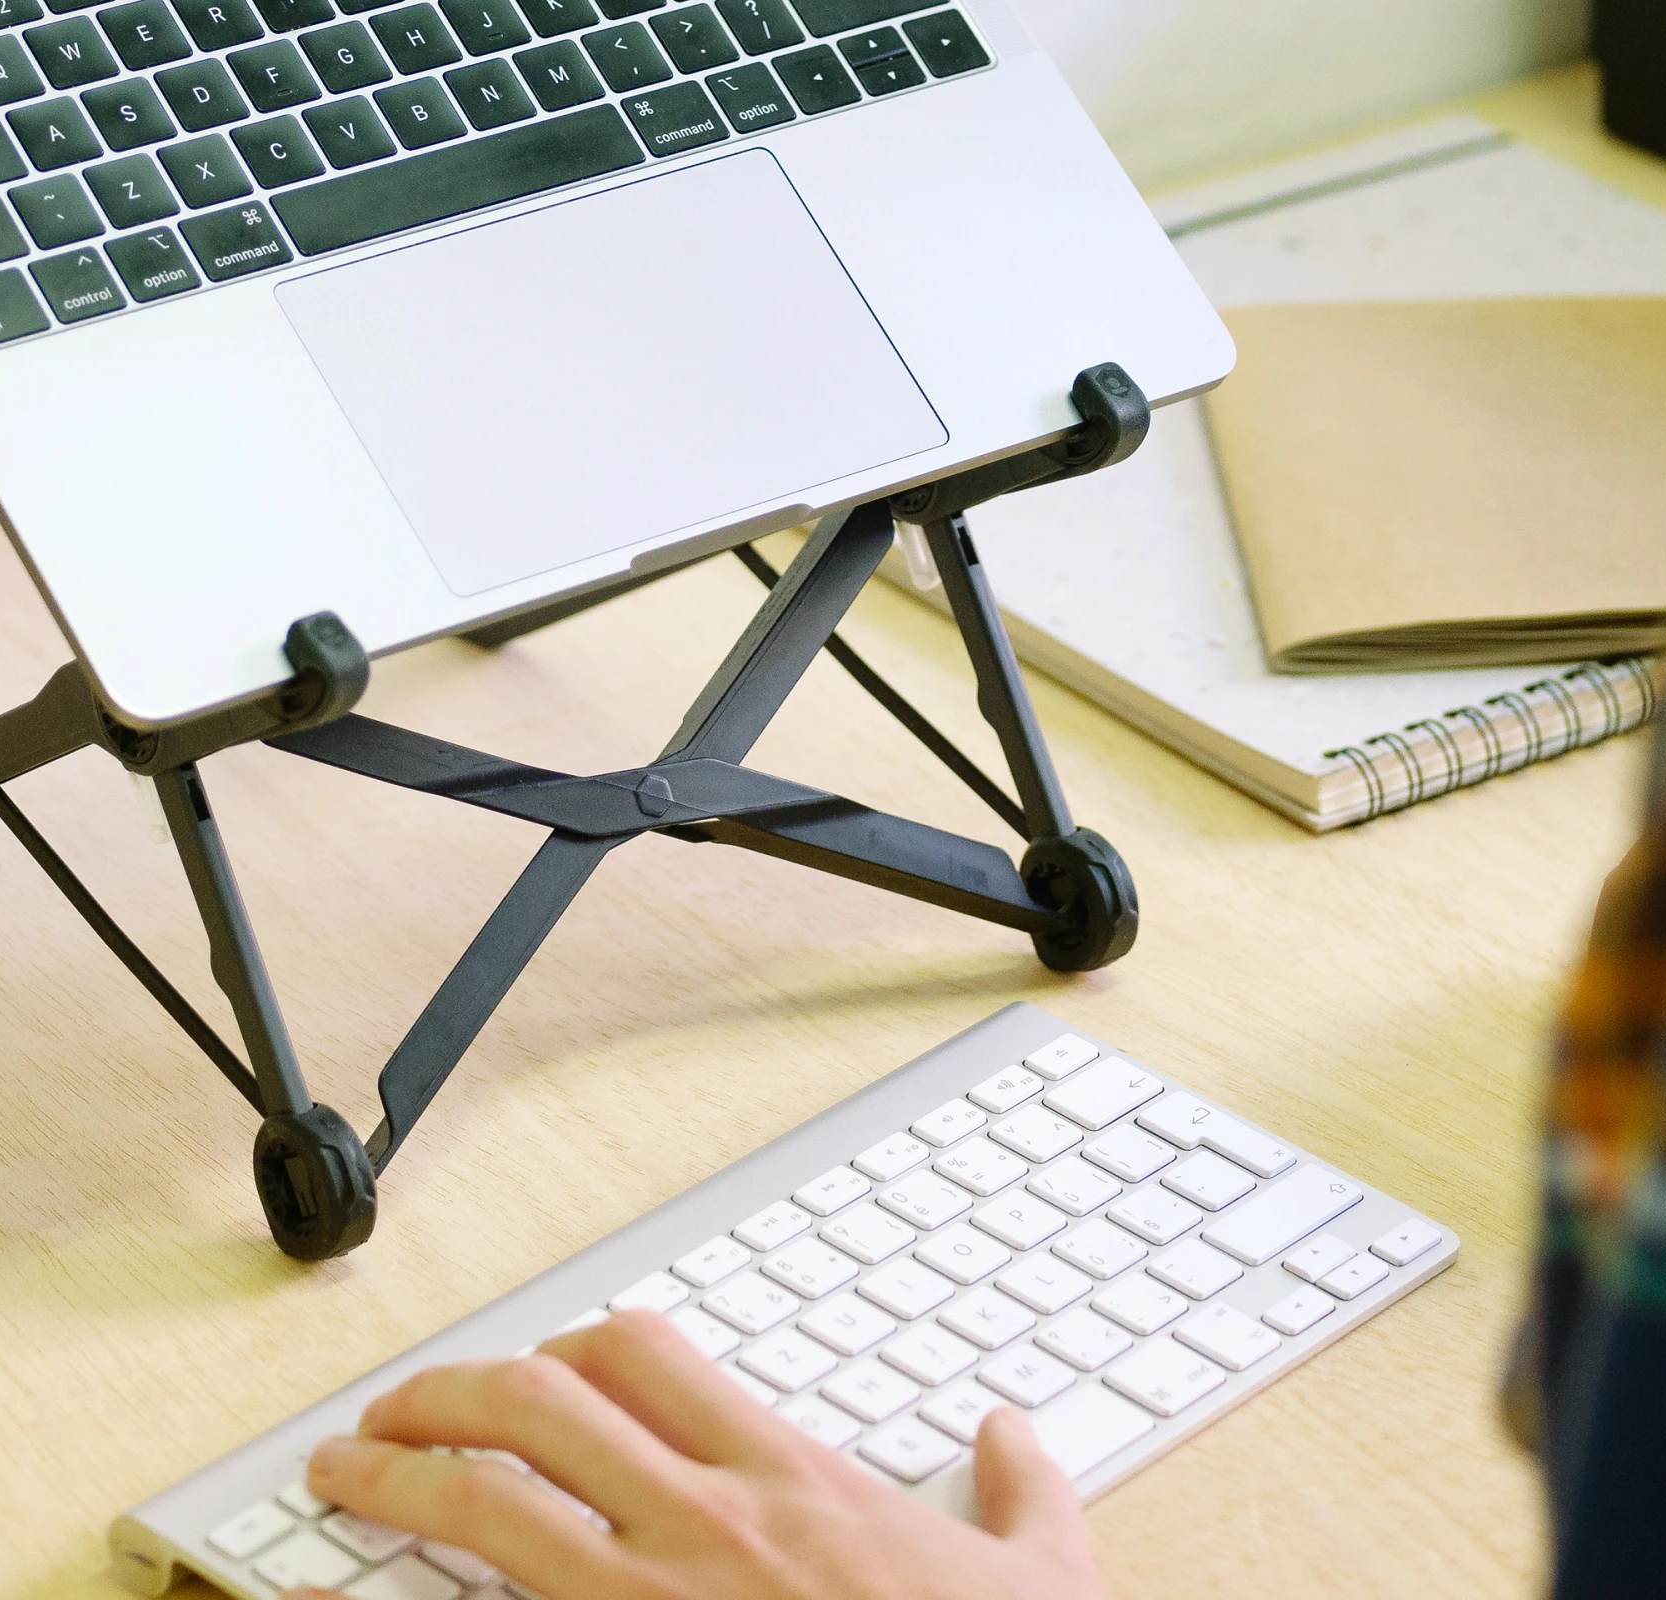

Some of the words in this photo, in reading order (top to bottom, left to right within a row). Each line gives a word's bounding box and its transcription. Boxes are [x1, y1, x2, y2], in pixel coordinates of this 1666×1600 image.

[207, 6, 227, 23] R
[482, 11, 493, 28] J
[136, 24, 154, 42] E
[405, 29, 426, 47] H
[58, 42, 81, 61] W
[337, 48, 354, 65] G
[265, 66, 279, 84] F
[548, 65, 570, 84] M
[192, 86, 210, 104] D
[480, 84, 501, 103] N
[120, 104, 137, 122] S
[410, 104, 429, 122] B
[738, 103, 778, 121] option
[49, 124, 66, 142] A
[338, 122, 355, 140] V
[655, 119, 715, 145] command
[269, 142, 287, 160] C
[195, 161, 216, 180] X
[121, 181, 142, 200] Z
[215, 241, 280, 268] command
[143, 268, 187, 289] option
[64, 287, 112, 310] control
[1008, 1209, 1024, 1223] P
[1034, 1274, 1055, 1285] L
[834, 1312, 857, 1326] U
[975, 1307, 999, 1321] K
[775, 1348, 800, 1364] Z
[1013, 1362, 1041, 1380] M
[856, 1376, 882, 1394] H
[954, 1398, 980, 1415] N
